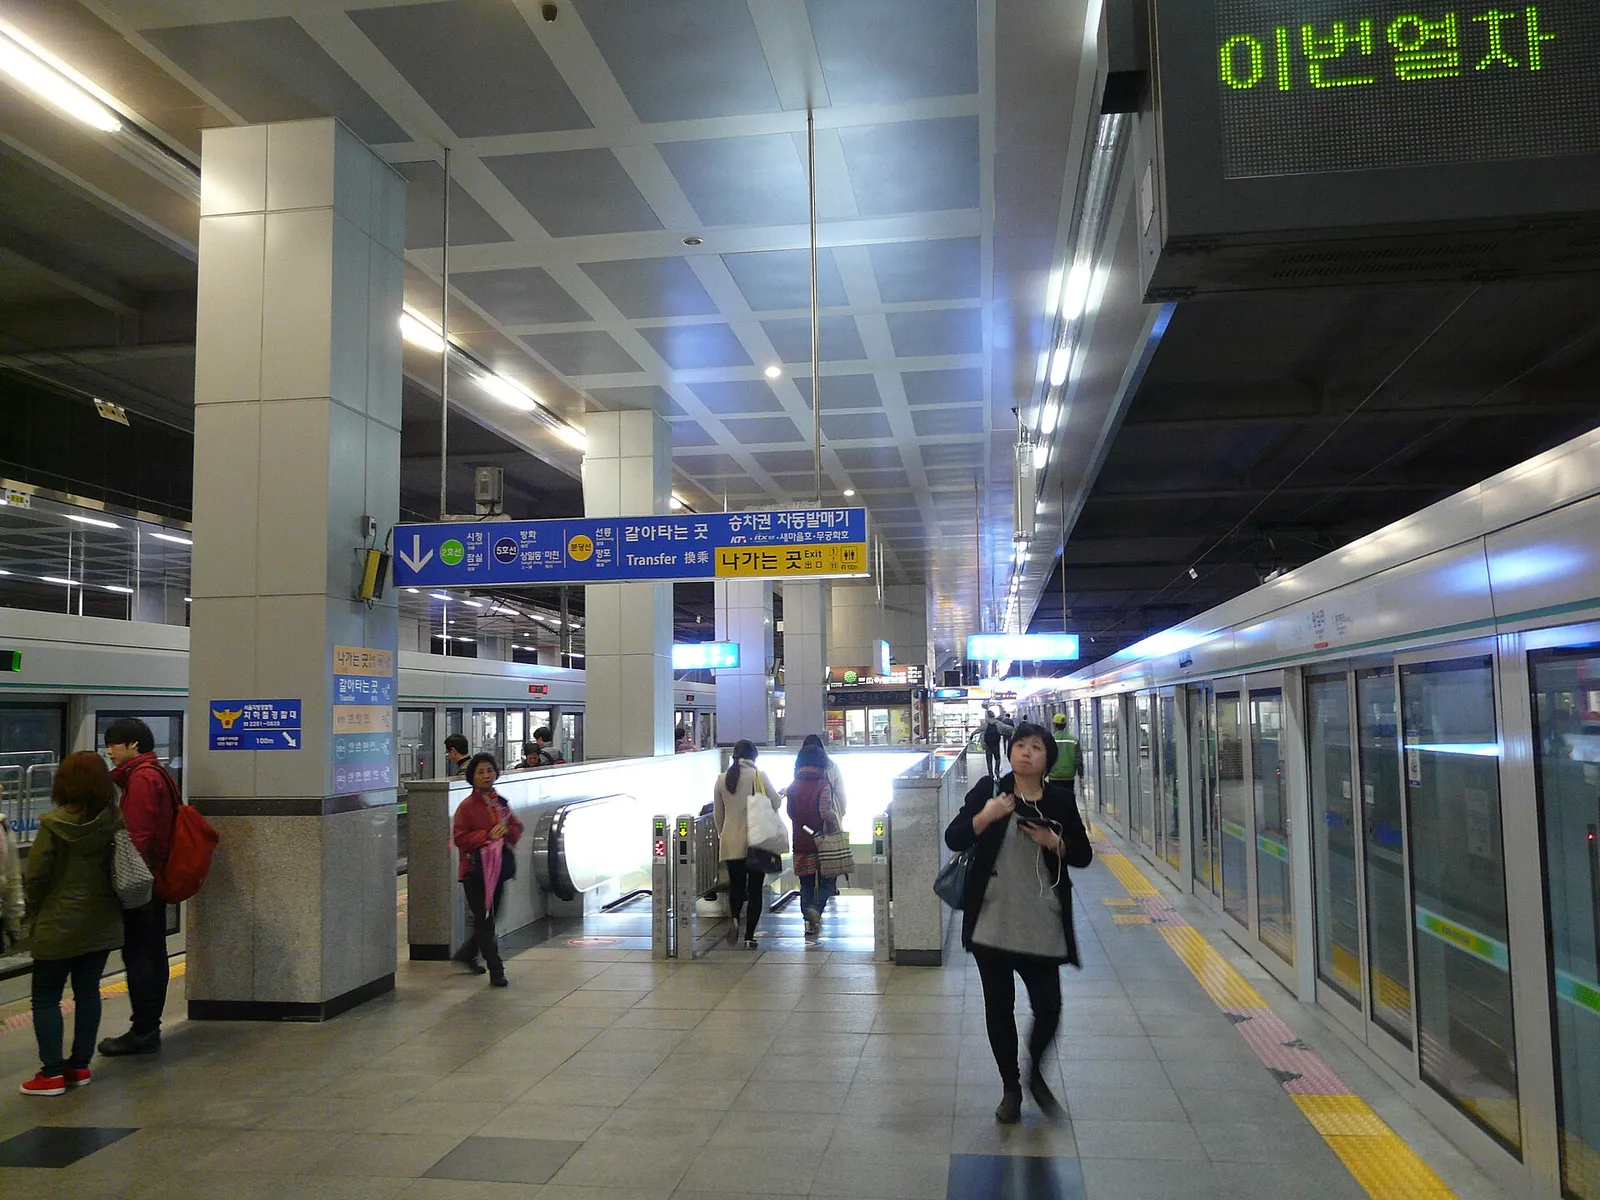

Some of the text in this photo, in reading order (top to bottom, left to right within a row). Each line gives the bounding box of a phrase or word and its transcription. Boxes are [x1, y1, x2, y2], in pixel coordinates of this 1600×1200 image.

[1220, 6, 1556, 92] 이번열차
[729, 511, 849, 532] 승차권 자동발매기
[467, 532, 483, 542] 시청
[520, 530, 537, 540] 방화
[625, 525, 688, 542] 갈아타는
[694, 523, 708, 540] 곳
[441, 548, 462, 557] 2호선
[496, 546, 517, 556] 5호선
[804, 549, 823, 559] Exit
[467, 553, 483, 563] 잠실
[626, 552, 677, 566] Transfer
[684, 550, 709, 564] 換乘
[722, 551, 802, 571] 나가는 곳
[337, 651, 360, 668] 나가는
[361, 653, 369, 668] 곳
[339, 678, 379, 695] 갈아타는 곳
[255, 737, 275, 745] 100m
